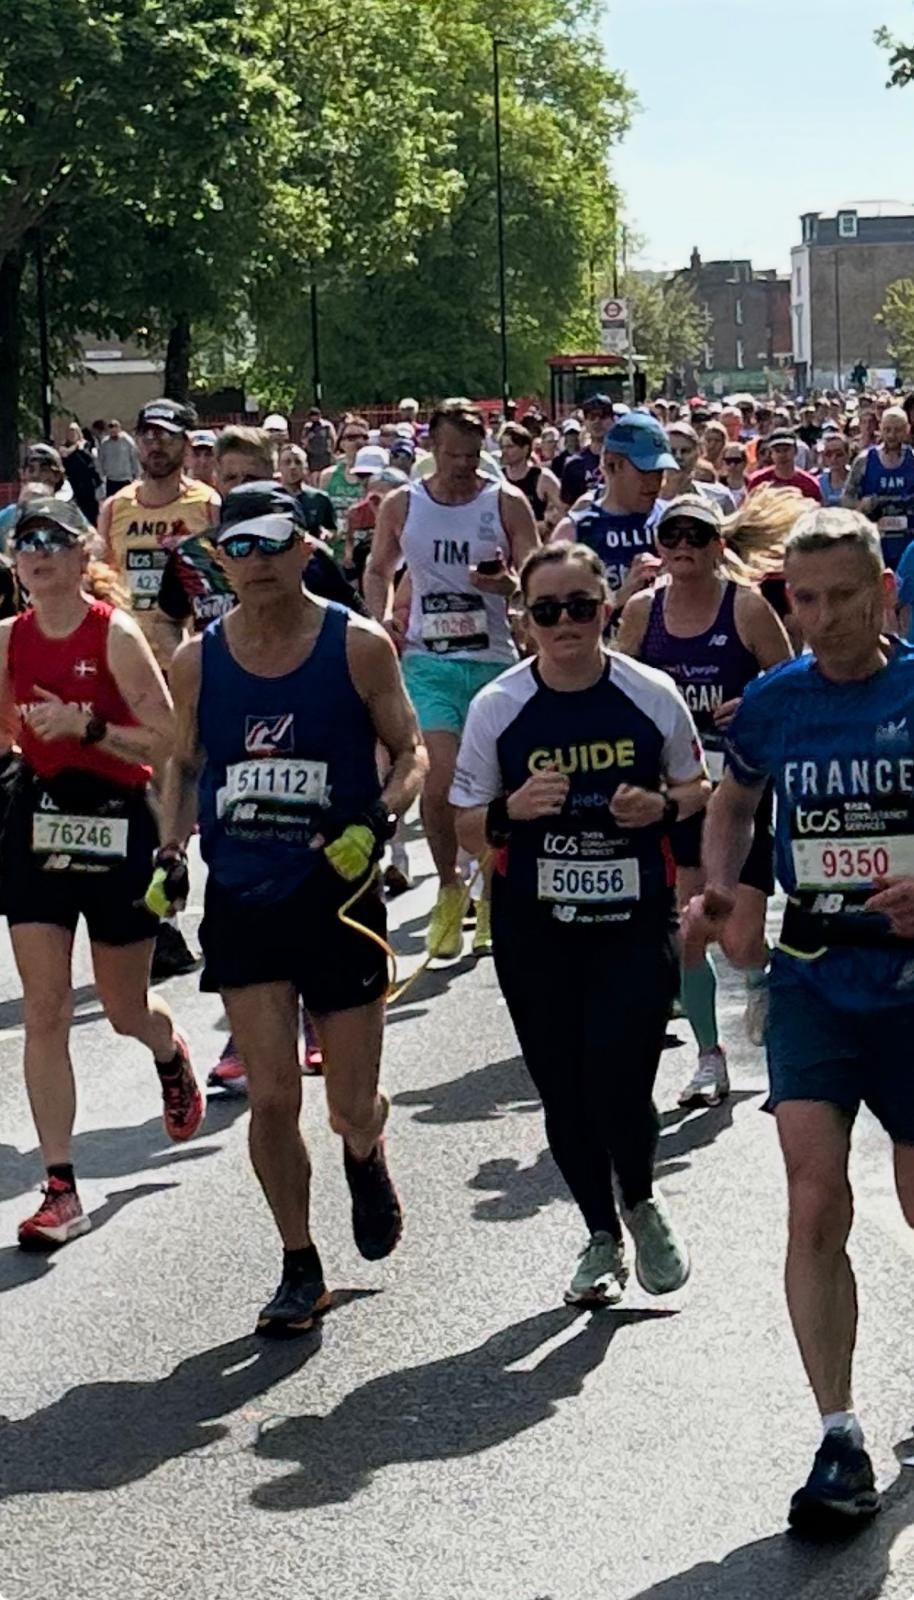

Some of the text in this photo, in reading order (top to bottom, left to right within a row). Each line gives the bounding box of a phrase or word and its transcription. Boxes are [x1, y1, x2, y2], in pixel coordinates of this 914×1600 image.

[606, 527, 653, 548] OLLI
[433, 539, 470, 565] TIM
[527, 739, 636, 776] GUIDE
[238, 767, 309, 795] 51112
[784, 759, 914, 797] FRANCE
[796, 804, 842, 834] tcs
[48, 822, 114, 848] 76246
[544, 832, 578, 855] tcs
[822, 847, 889, 878] 9350
[552, 867, 625, 893] 50656
[552, 904, 577, 922] NB
[811, 893, 844, 913] NB
